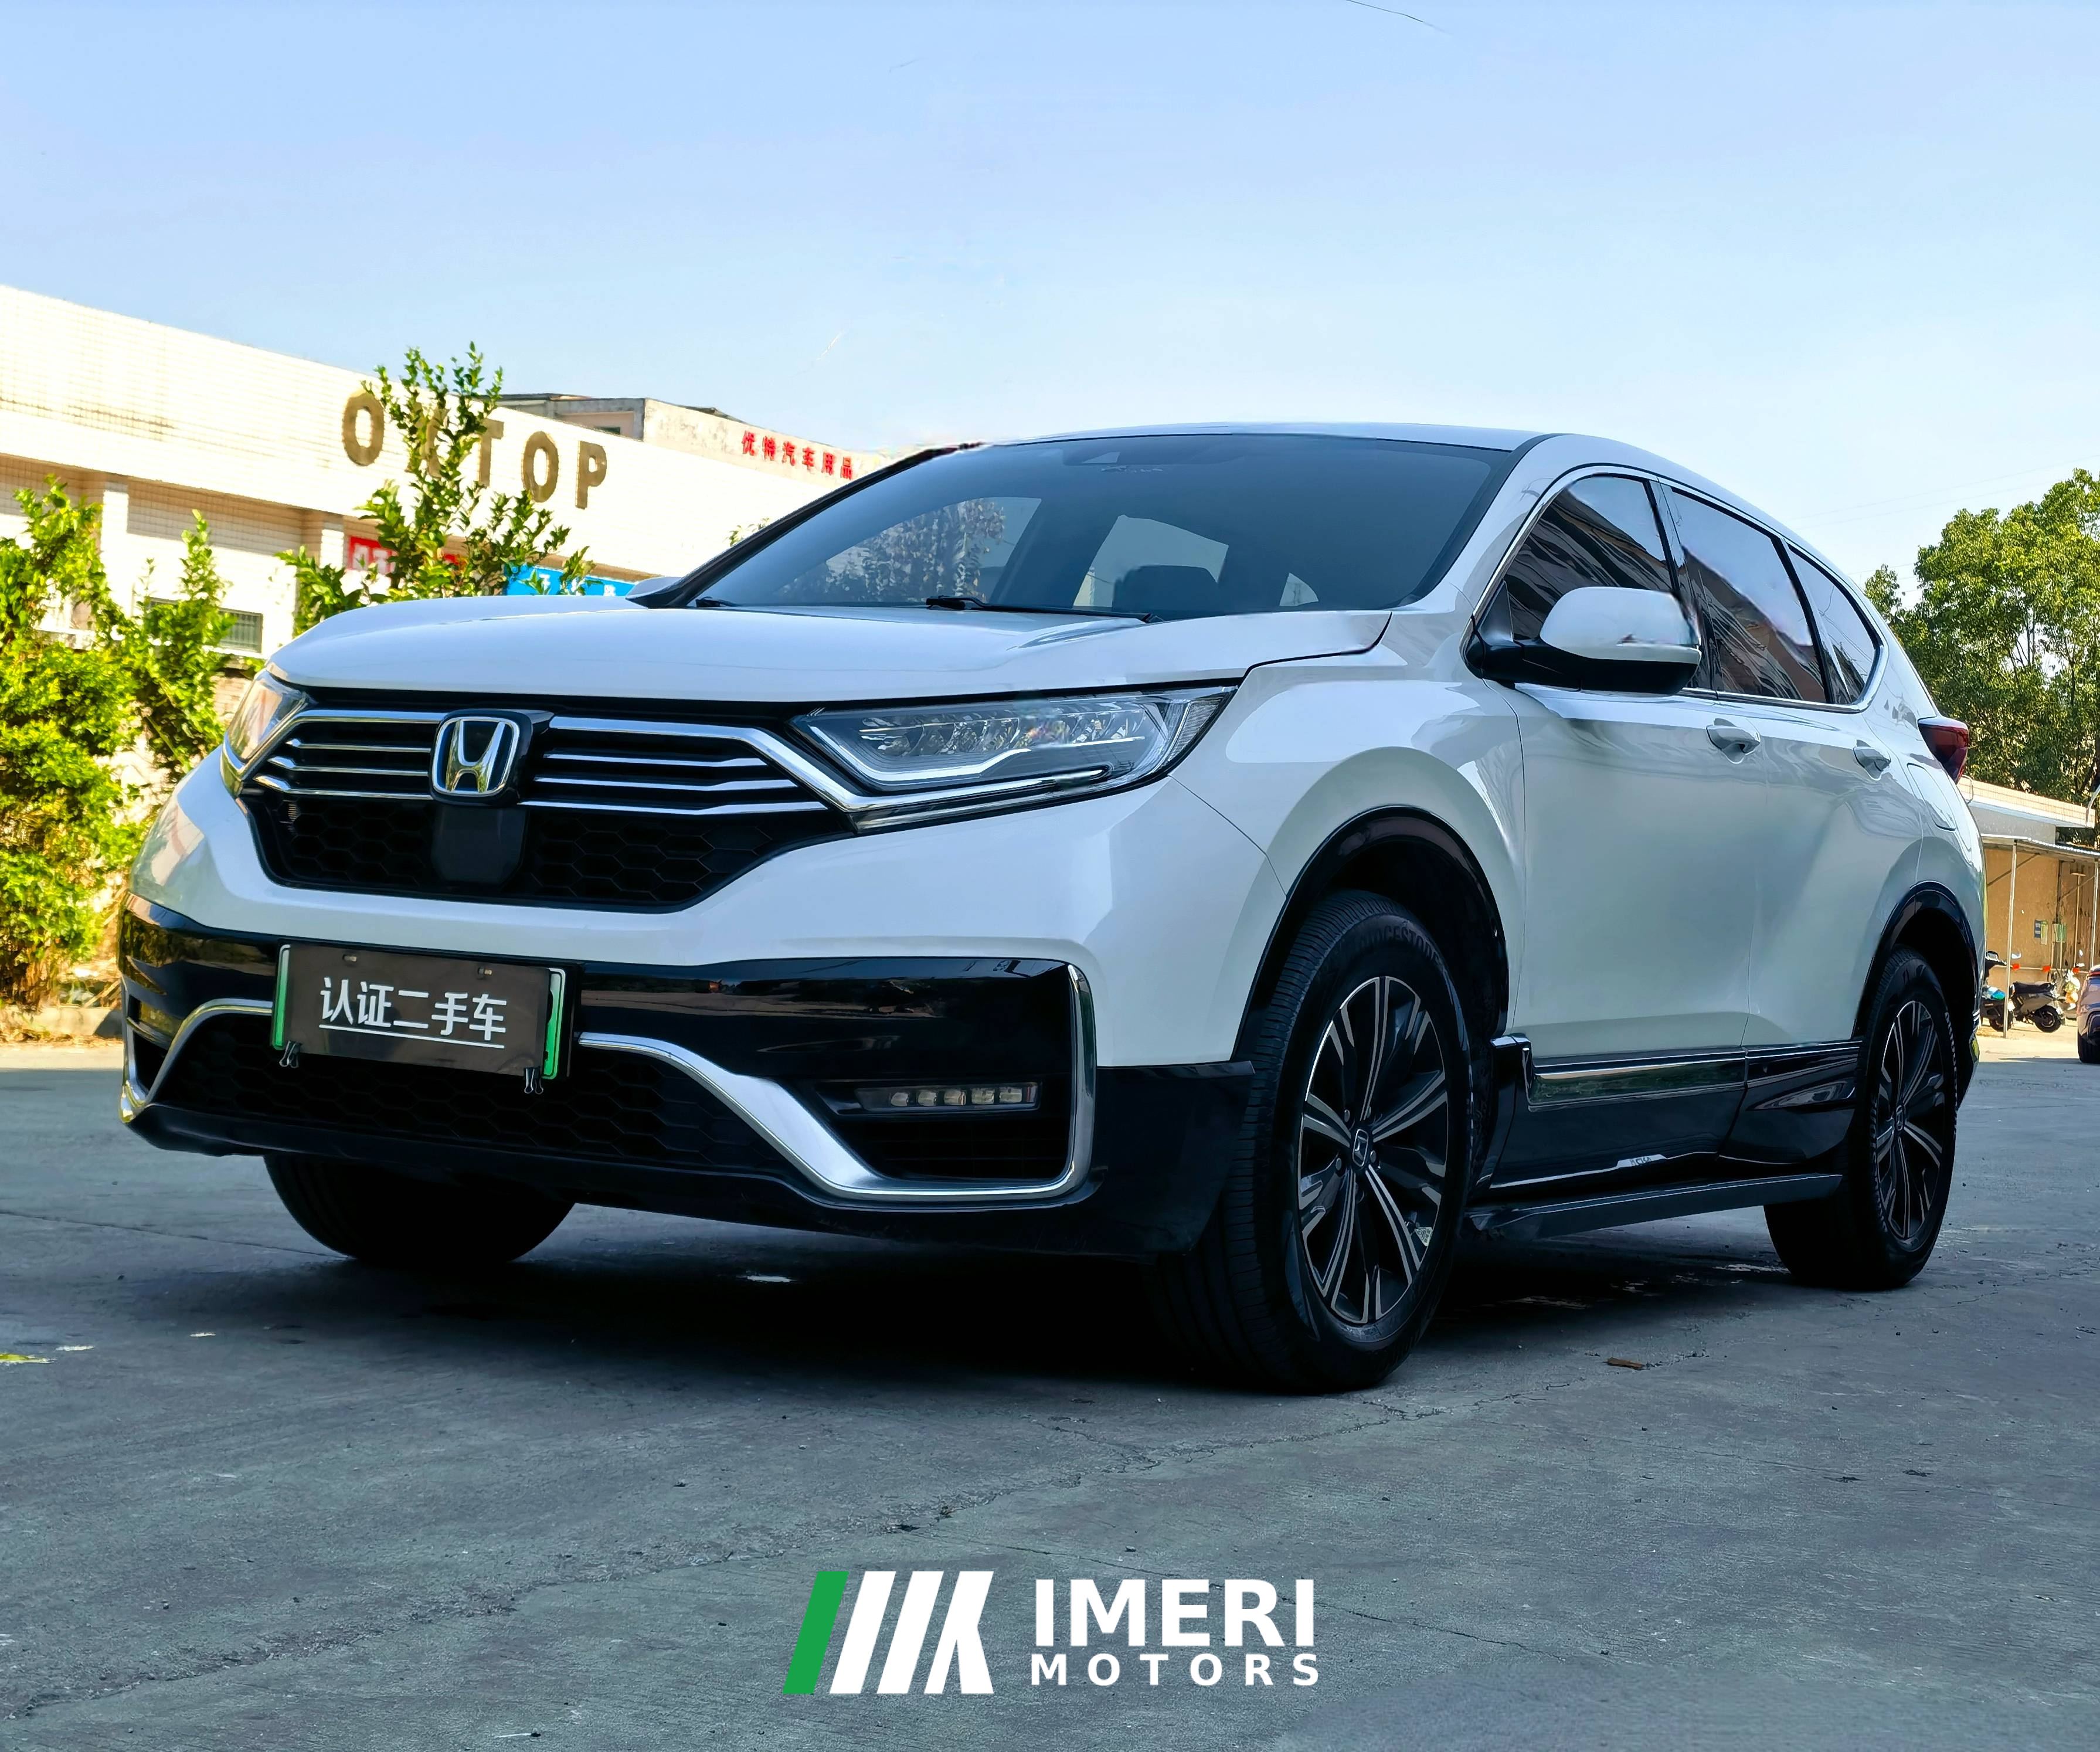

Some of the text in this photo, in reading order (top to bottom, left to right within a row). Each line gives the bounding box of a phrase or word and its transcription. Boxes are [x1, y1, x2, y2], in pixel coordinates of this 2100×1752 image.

[742, 430, 853, 480] 优特汽车用品
[320, 977, 507, 1041] 认证二手车
